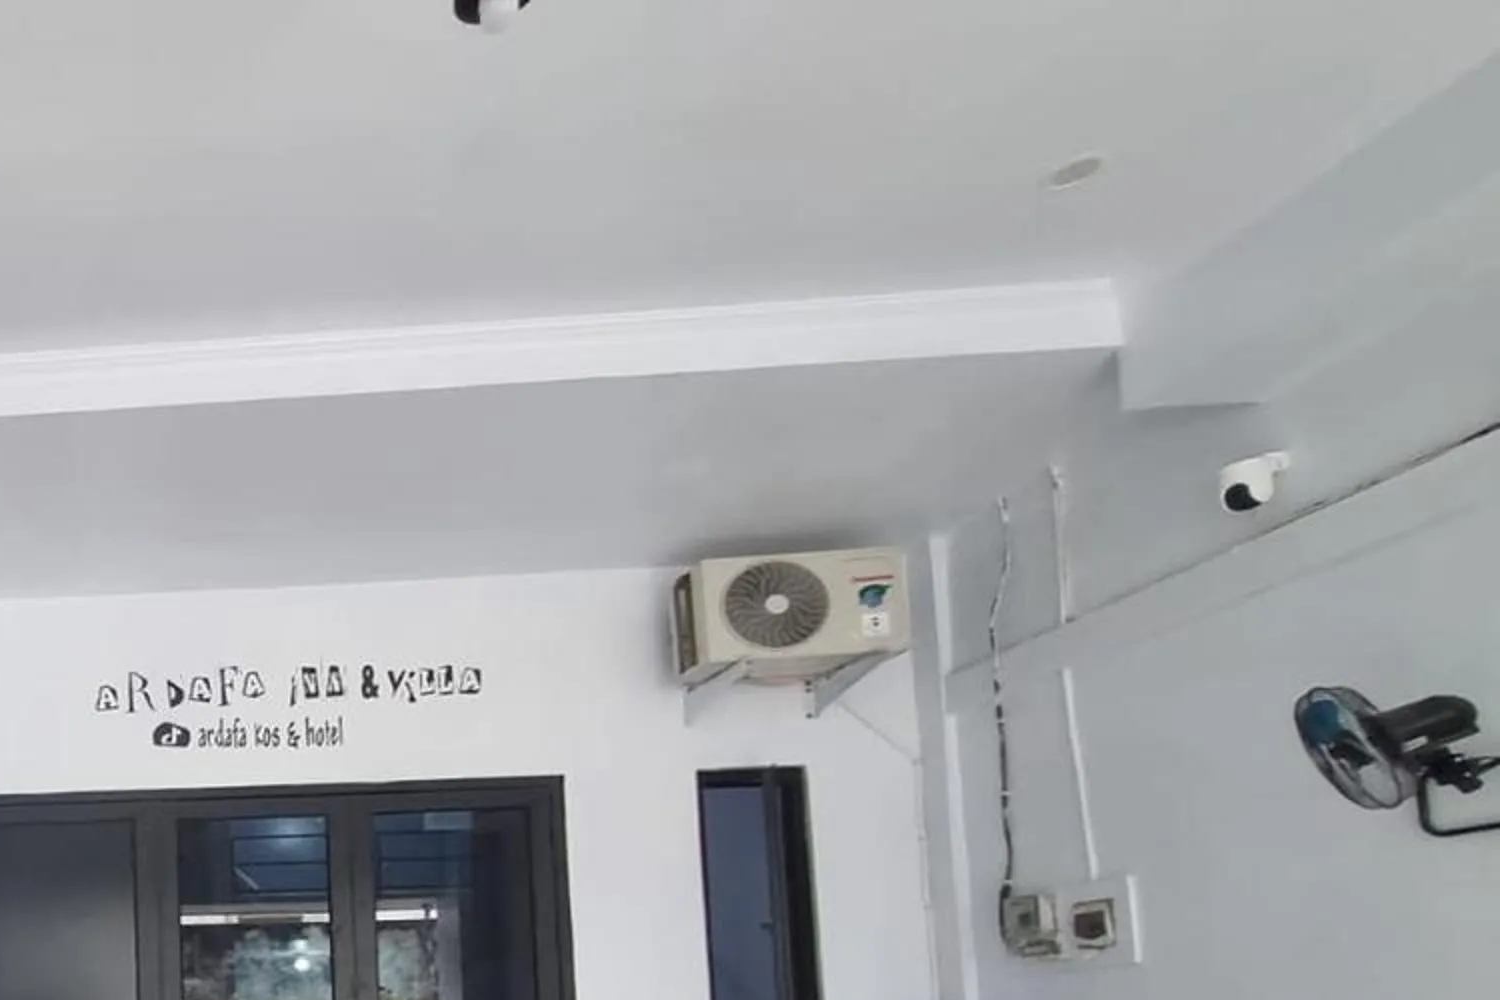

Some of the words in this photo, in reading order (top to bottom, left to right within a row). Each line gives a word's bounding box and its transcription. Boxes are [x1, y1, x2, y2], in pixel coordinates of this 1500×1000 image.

[361, 664, 380, 699] &
[198, 717, 247, 748] ardafa
[287, 721, 301, 748] &
[304, 716, 343, 747] hotel
